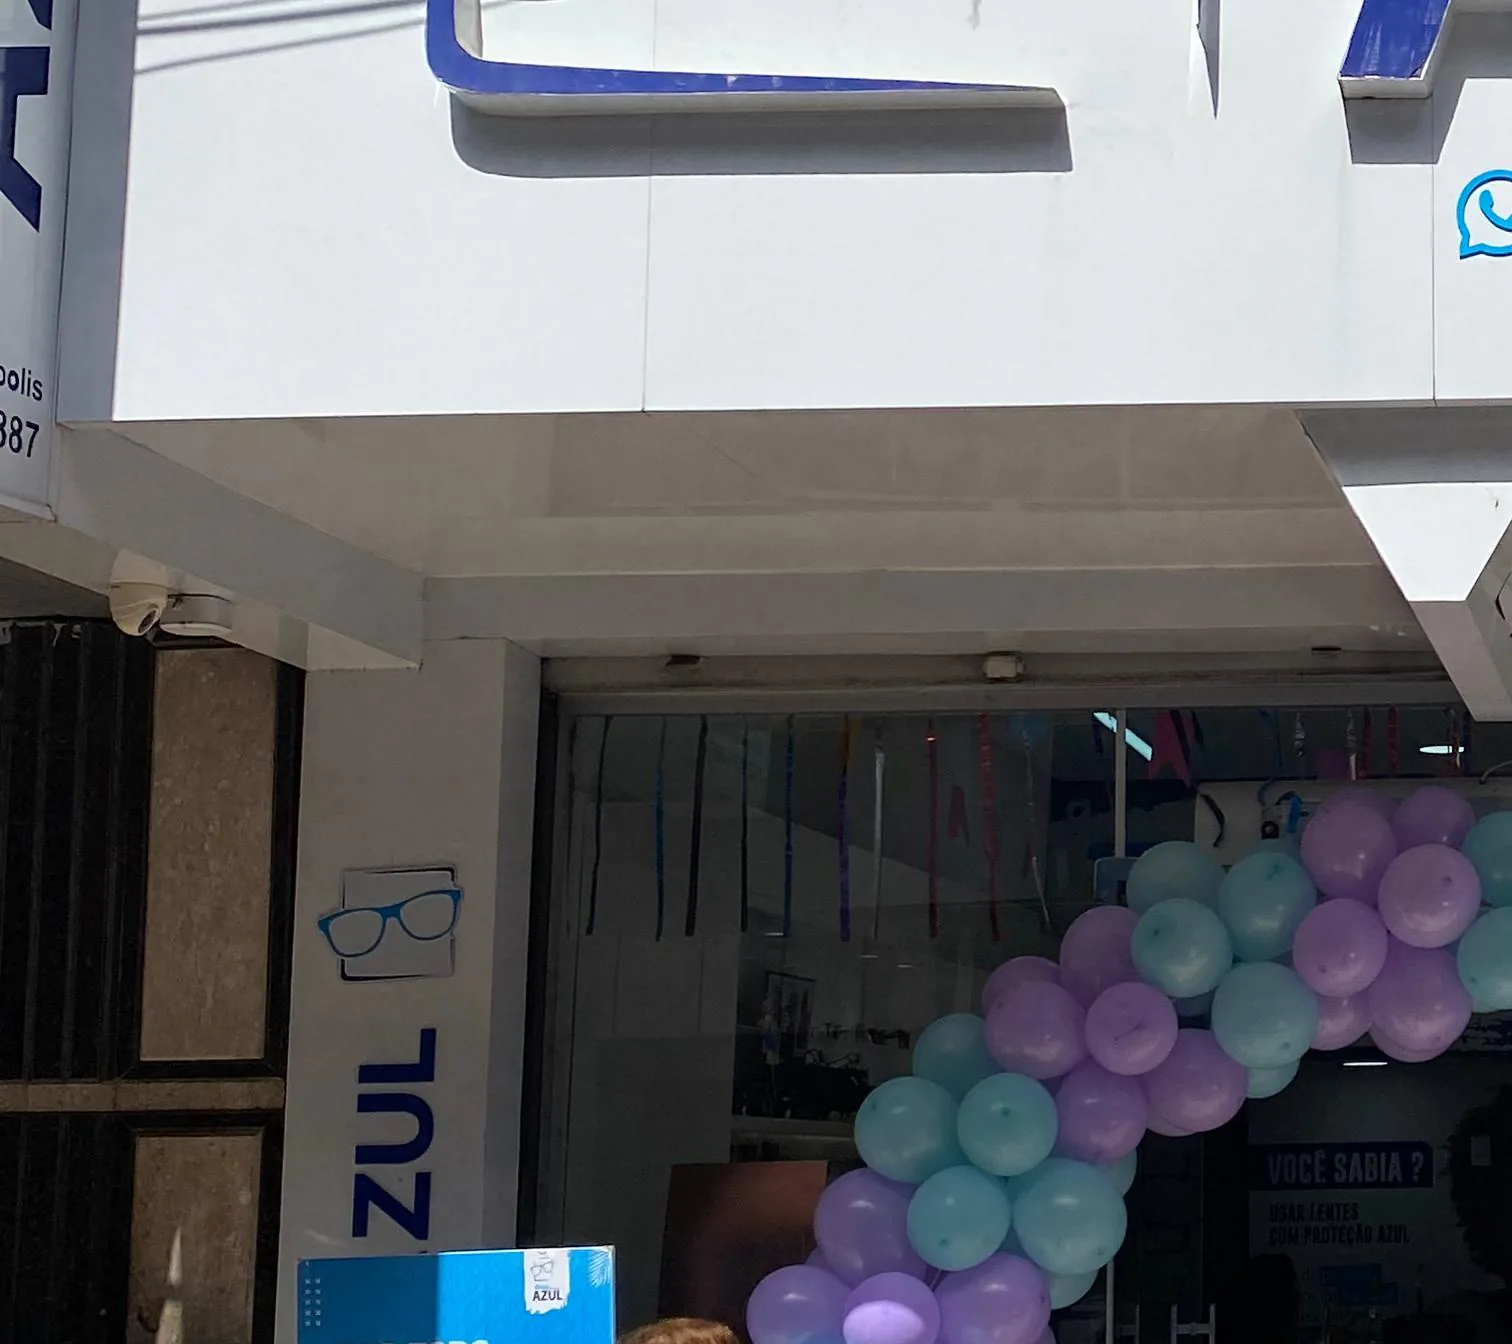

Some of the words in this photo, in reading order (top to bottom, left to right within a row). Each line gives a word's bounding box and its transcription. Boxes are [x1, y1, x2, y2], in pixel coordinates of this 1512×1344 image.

[0, 365, 43, 401] olis
[352, 1027, 437, 1242] ZUL
[1267, 1148, 1327, 1185] VOCÊ
[1333, 1150, 1404, 1184] SABIA
[532, 1288, 563, 1302] AZUL
